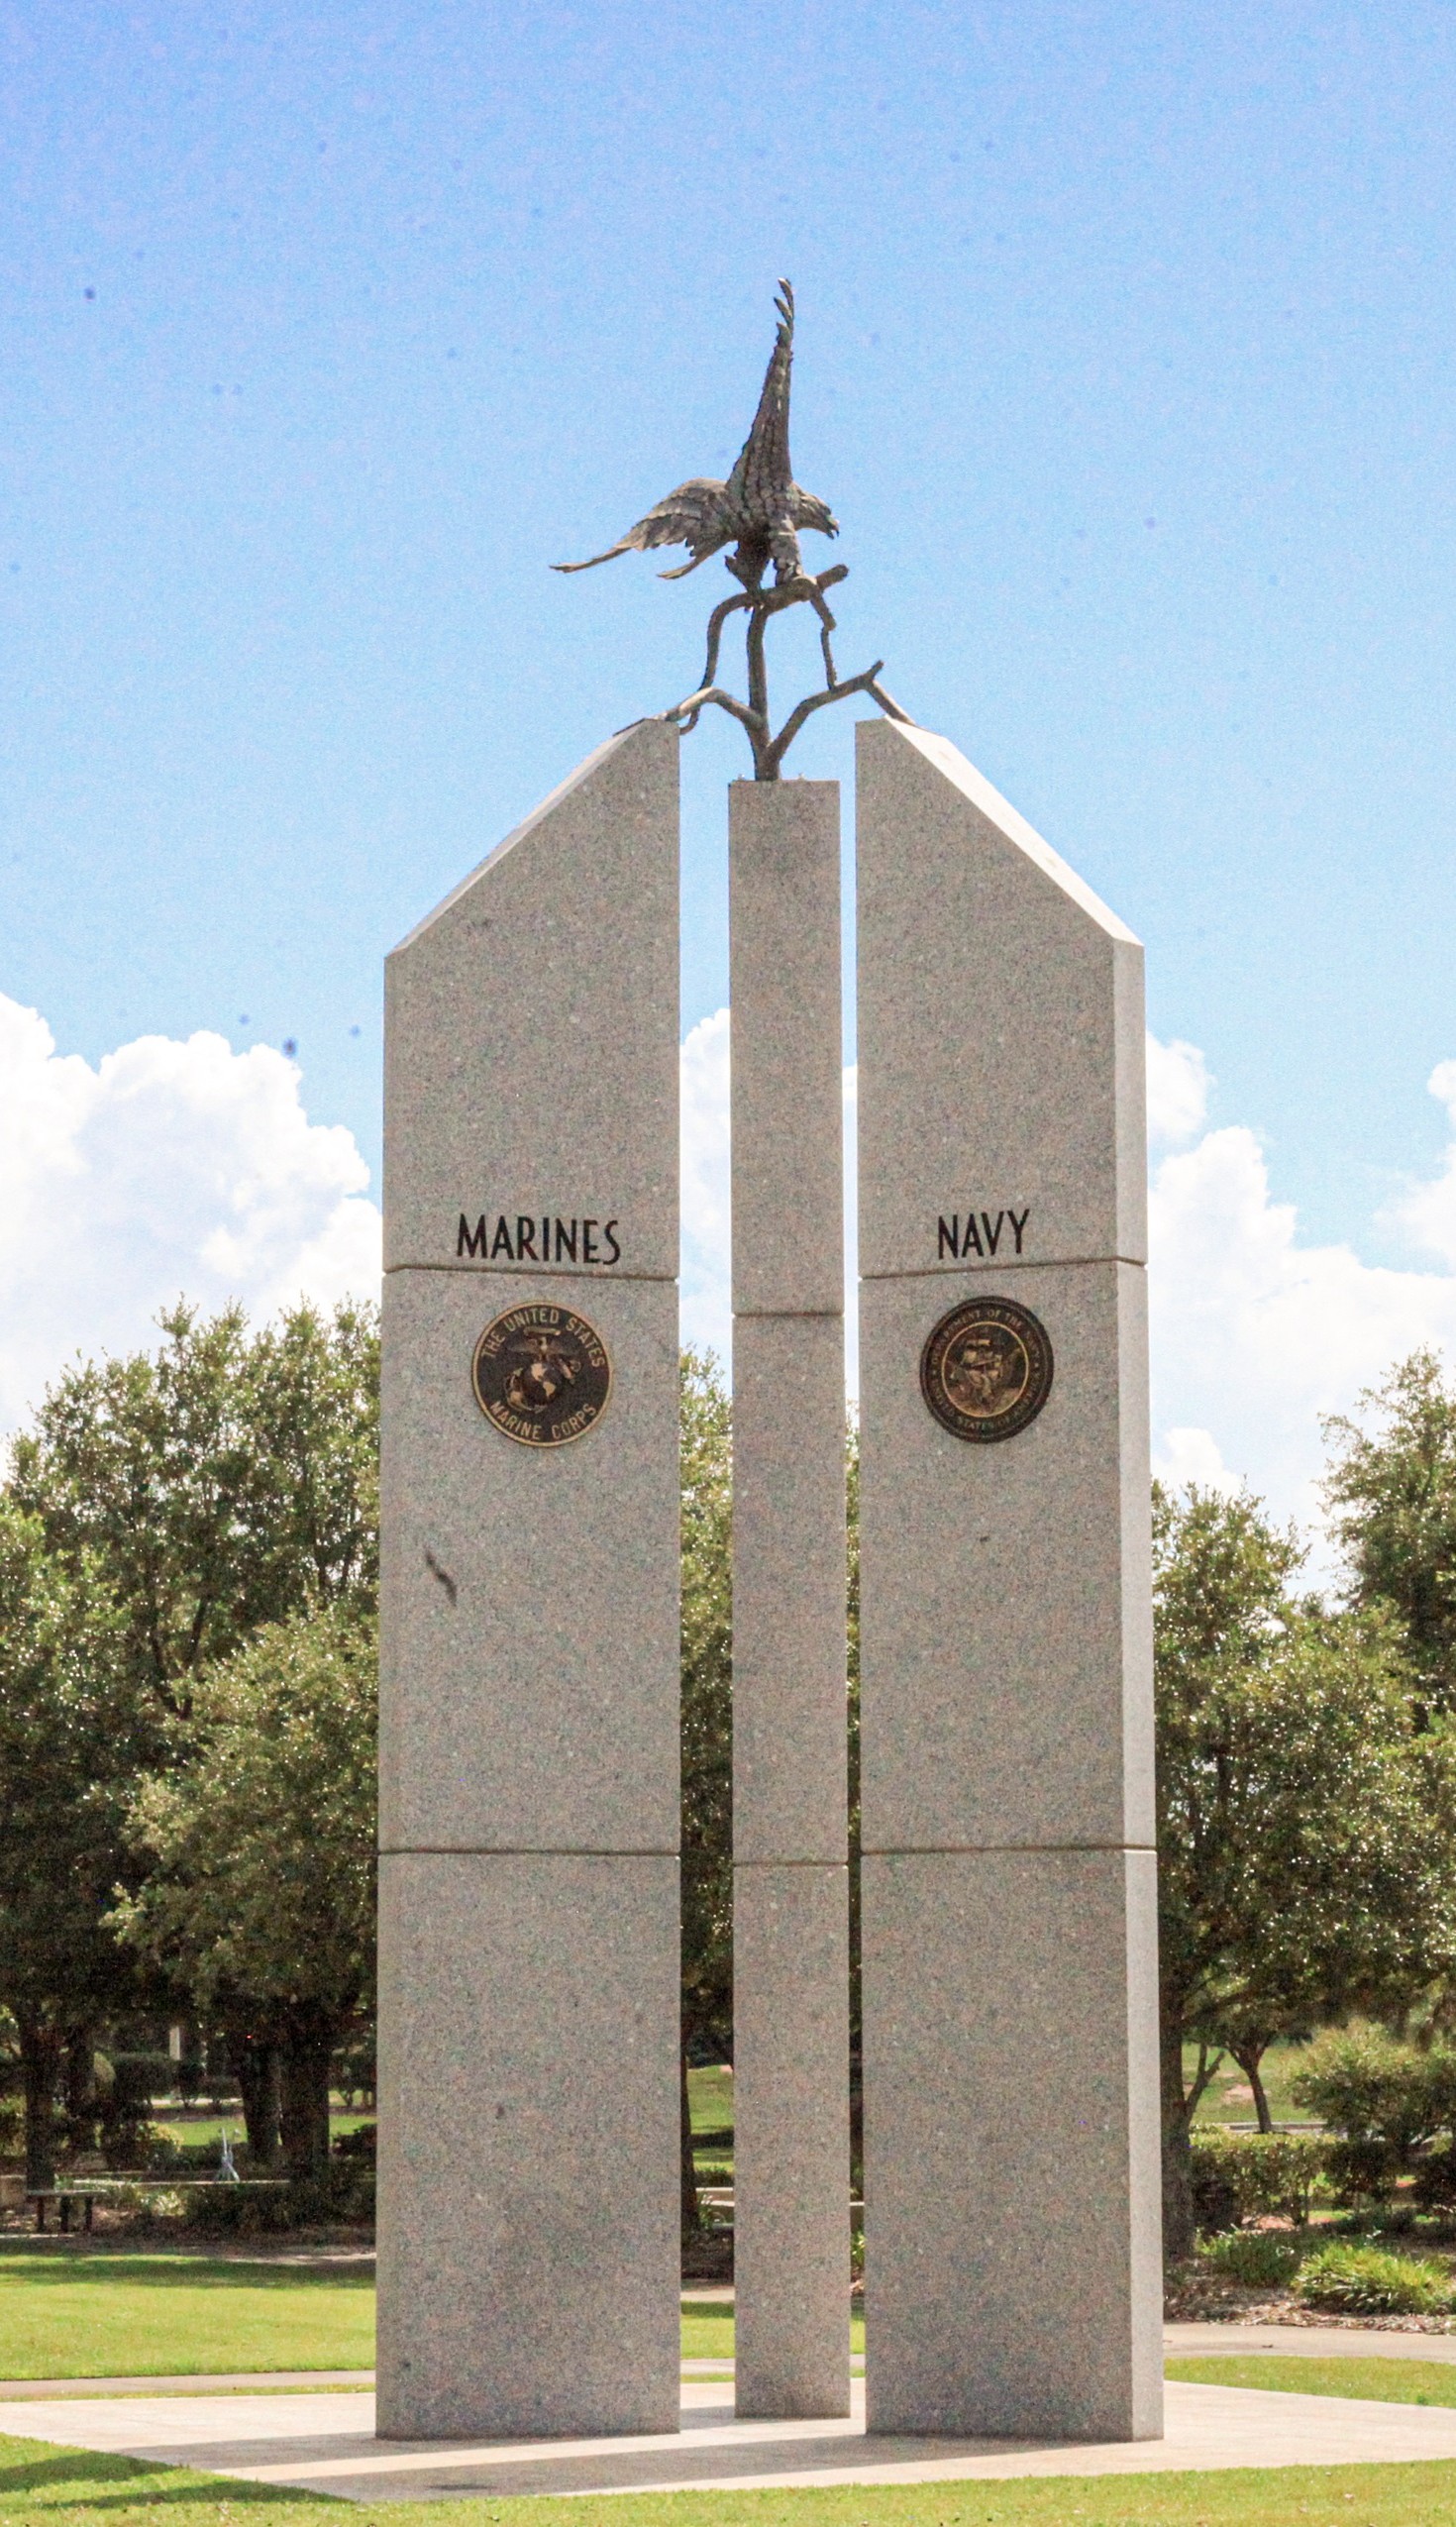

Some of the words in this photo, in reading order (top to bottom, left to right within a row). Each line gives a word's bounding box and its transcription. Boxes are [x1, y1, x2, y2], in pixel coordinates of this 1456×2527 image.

[457, 1213, 621, 1265] MARINES
[938, 1209, 1030, 1259] NAVY
[481, 1332, 505, 1358] THE
[503, 1308, 560, 1331] UNITED
[566, 1317, 605, 1367] STATES
[987, 1310, 1001, 1319] OF
[489, 1400, 542, 1440] MARINE
[551, 1403, 596, 1439] CORPS
